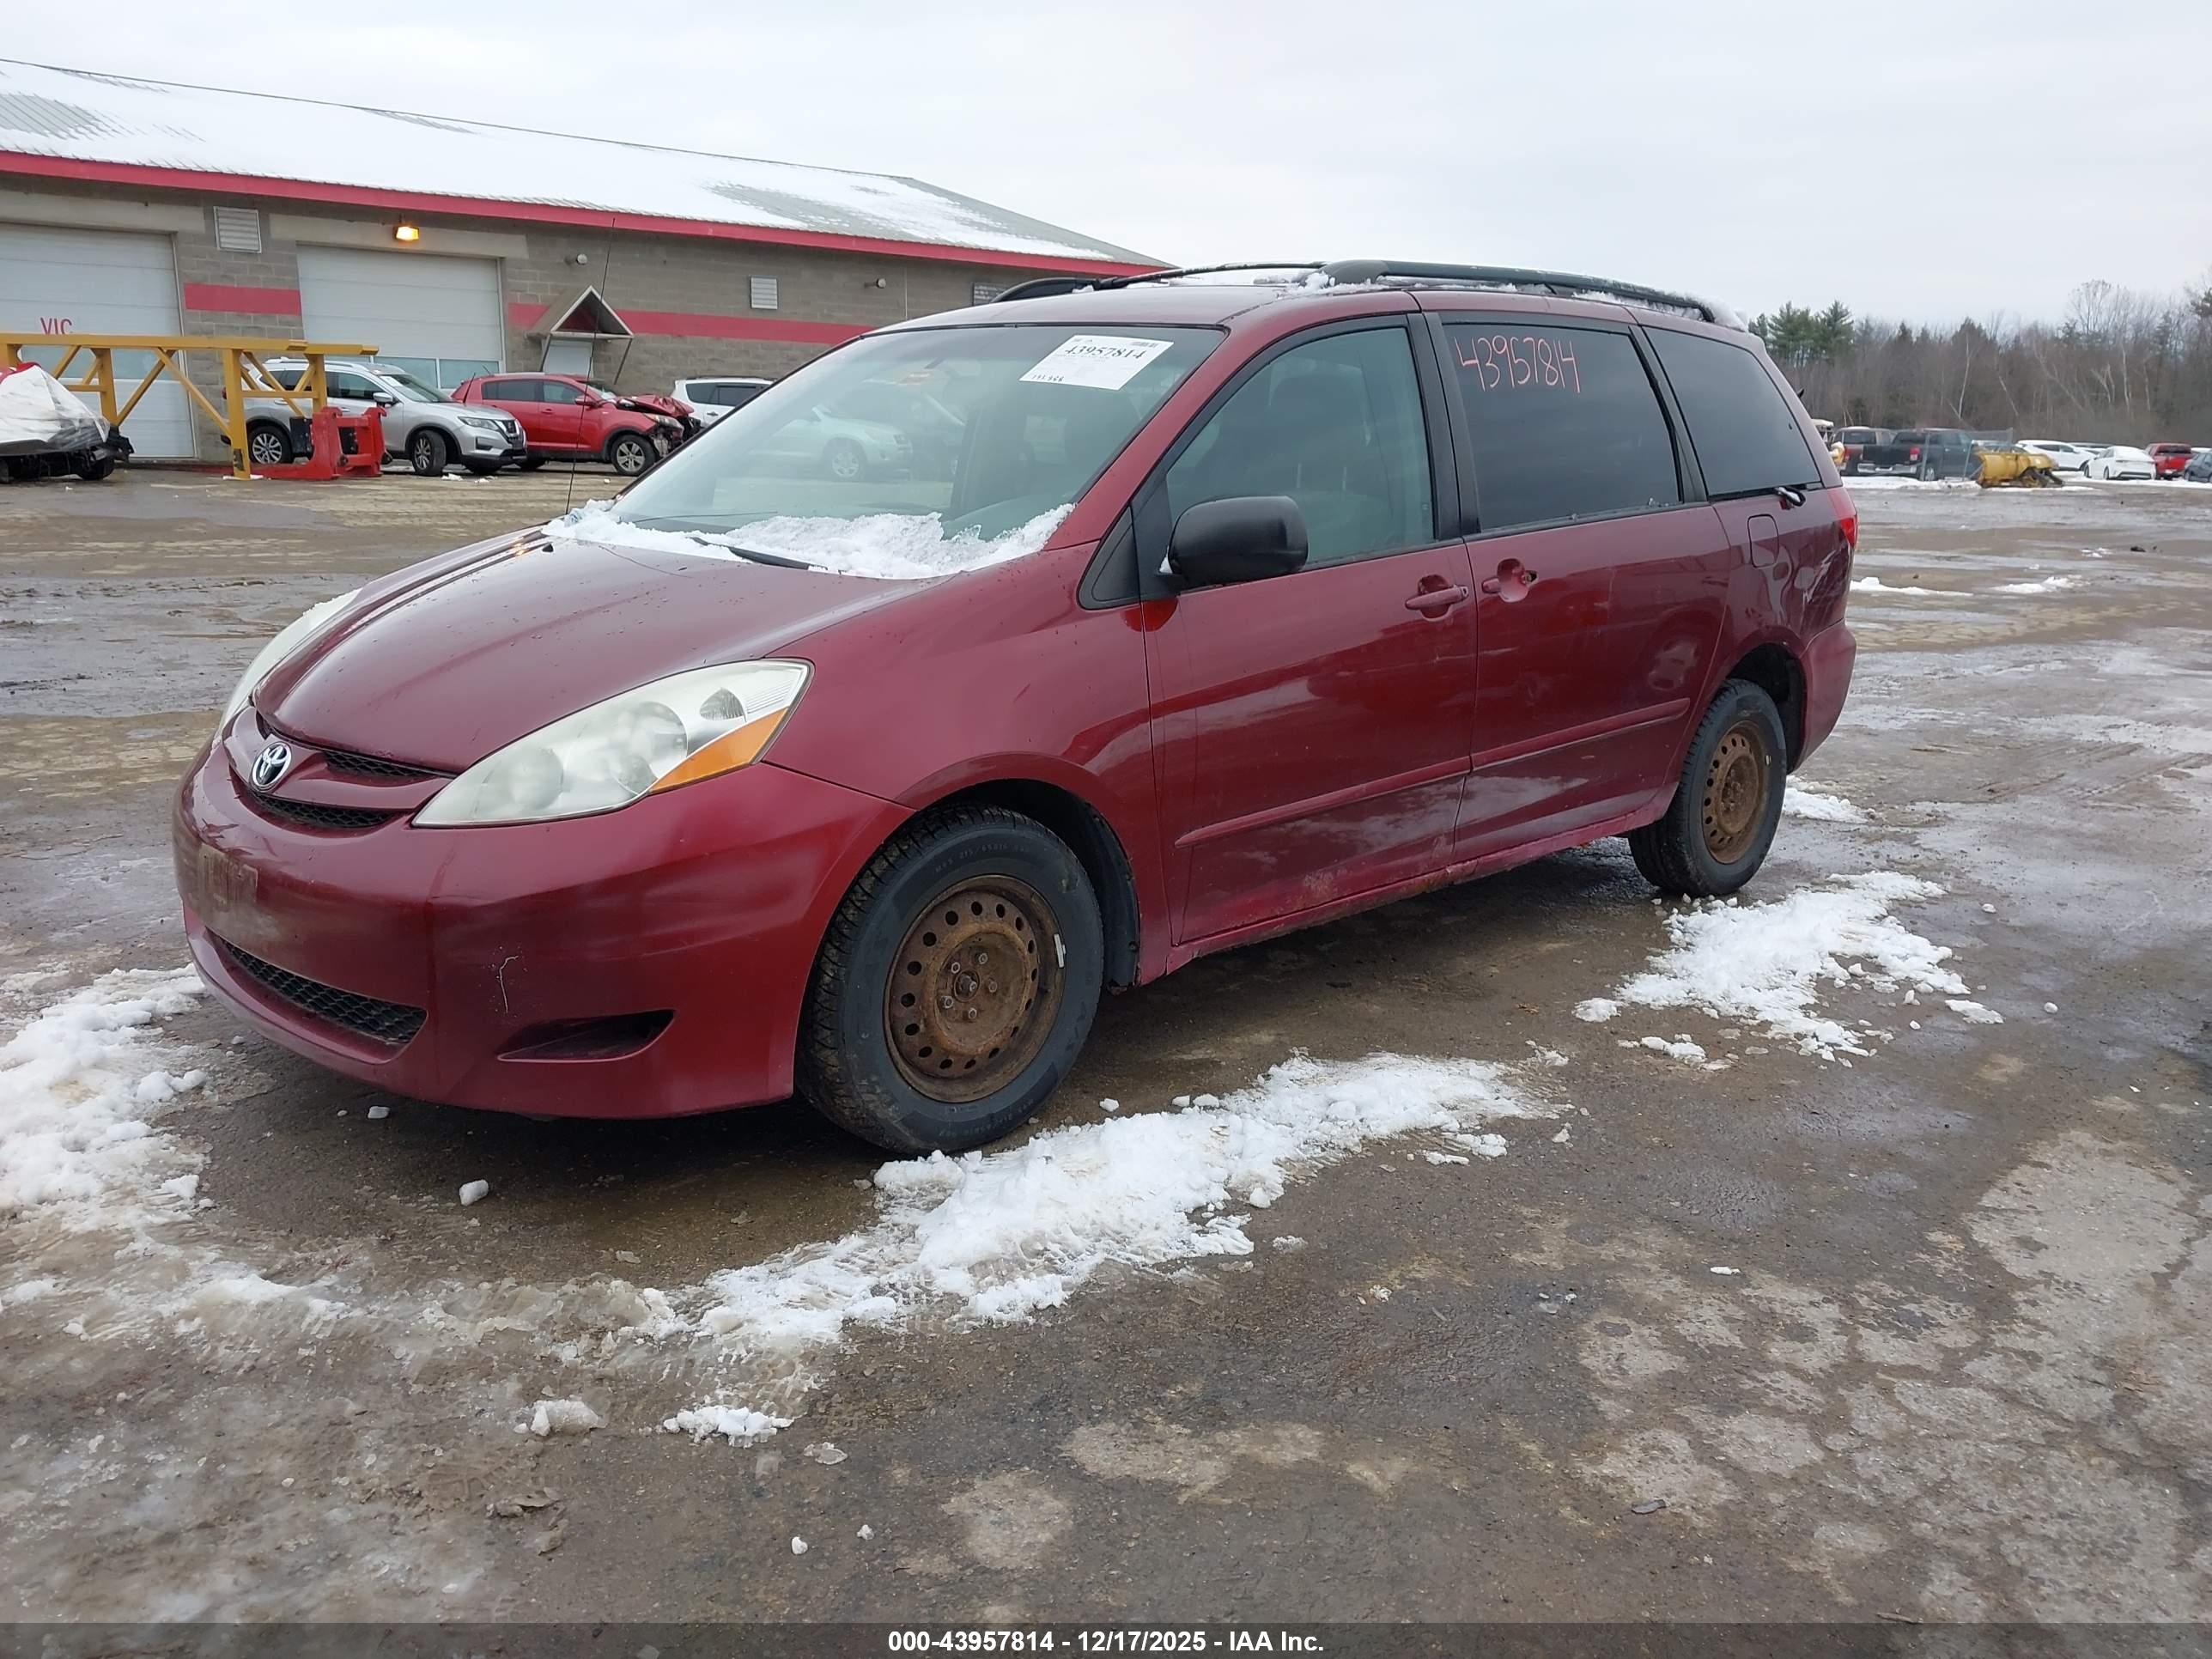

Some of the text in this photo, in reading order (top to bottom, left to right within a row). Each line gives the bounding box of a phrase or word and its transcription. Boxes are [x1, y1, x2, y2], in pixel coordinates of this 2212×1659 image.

[40, 317, 72, 335] VIC
[1064, 345, 1147, 360] 43957814
[1453, 335, 1581, 394] 43957814
